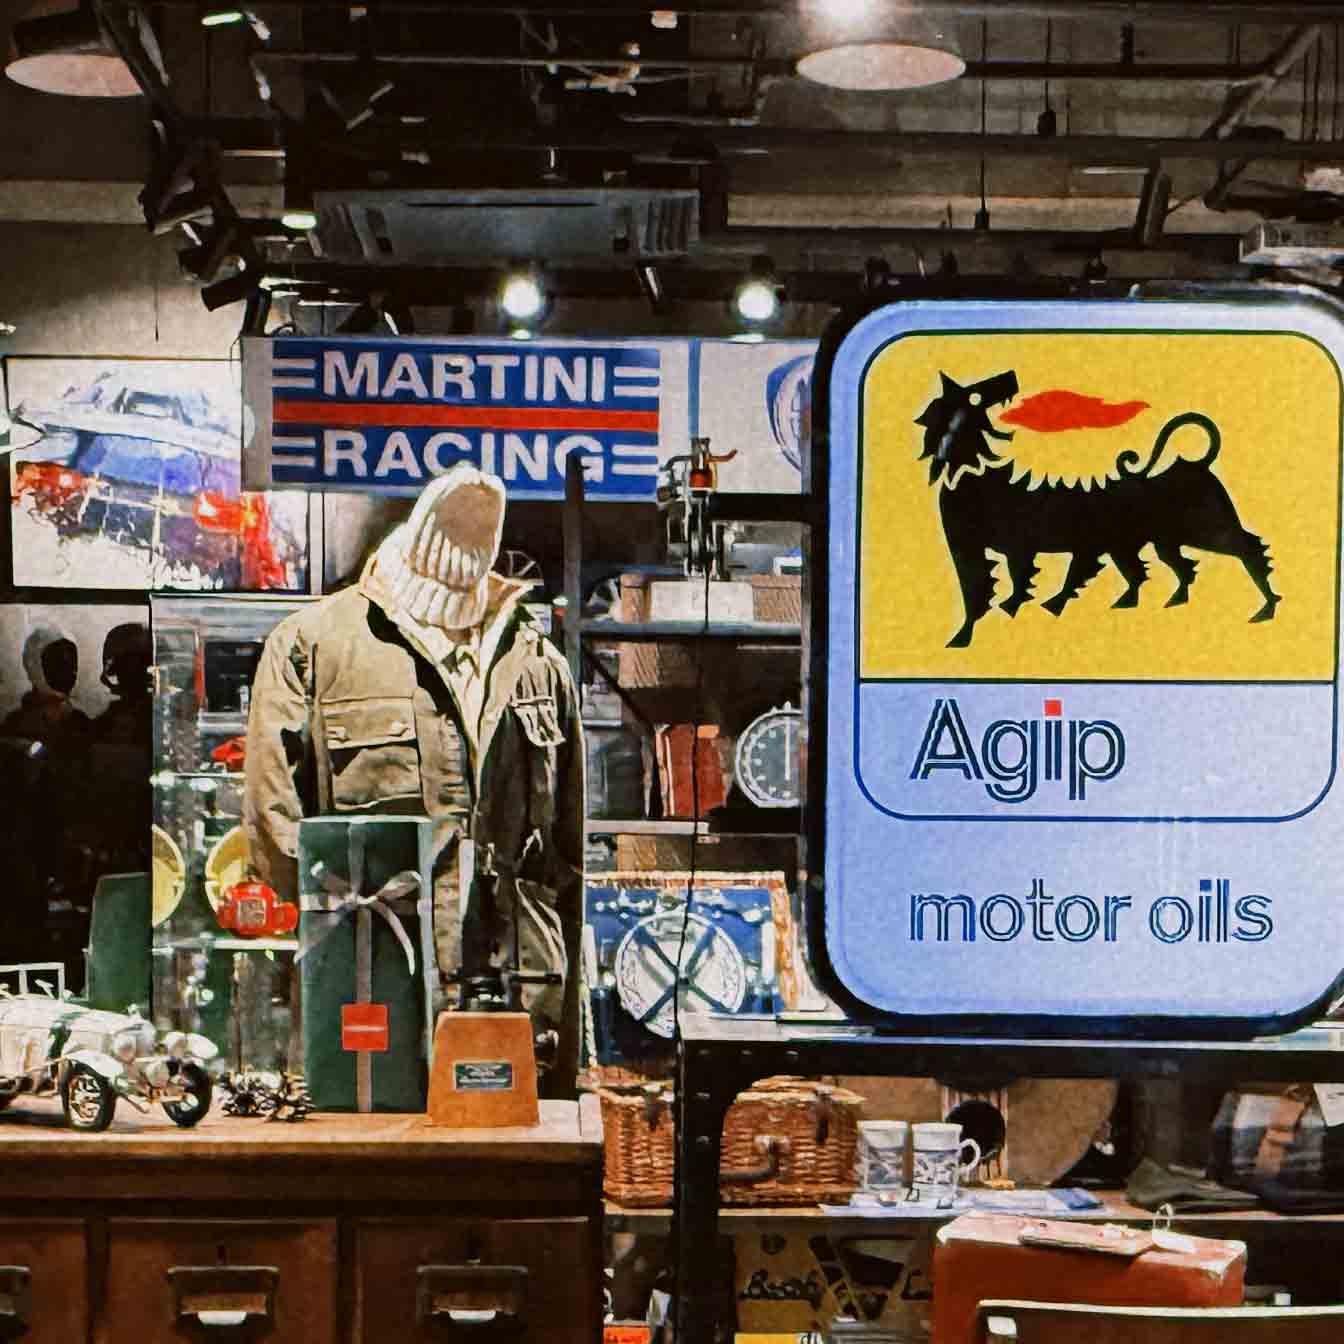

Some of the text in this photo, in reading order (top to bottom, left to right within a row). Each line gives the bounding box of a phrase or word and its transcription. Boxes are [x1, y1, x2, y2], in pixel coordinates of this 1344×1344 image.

[322, 350, 606, 403] MARTINI
[322, 430, 605, 483] RACING
[910, 698, 1127, 804] Agip
[908, 879, 1274, 944] motor oils
